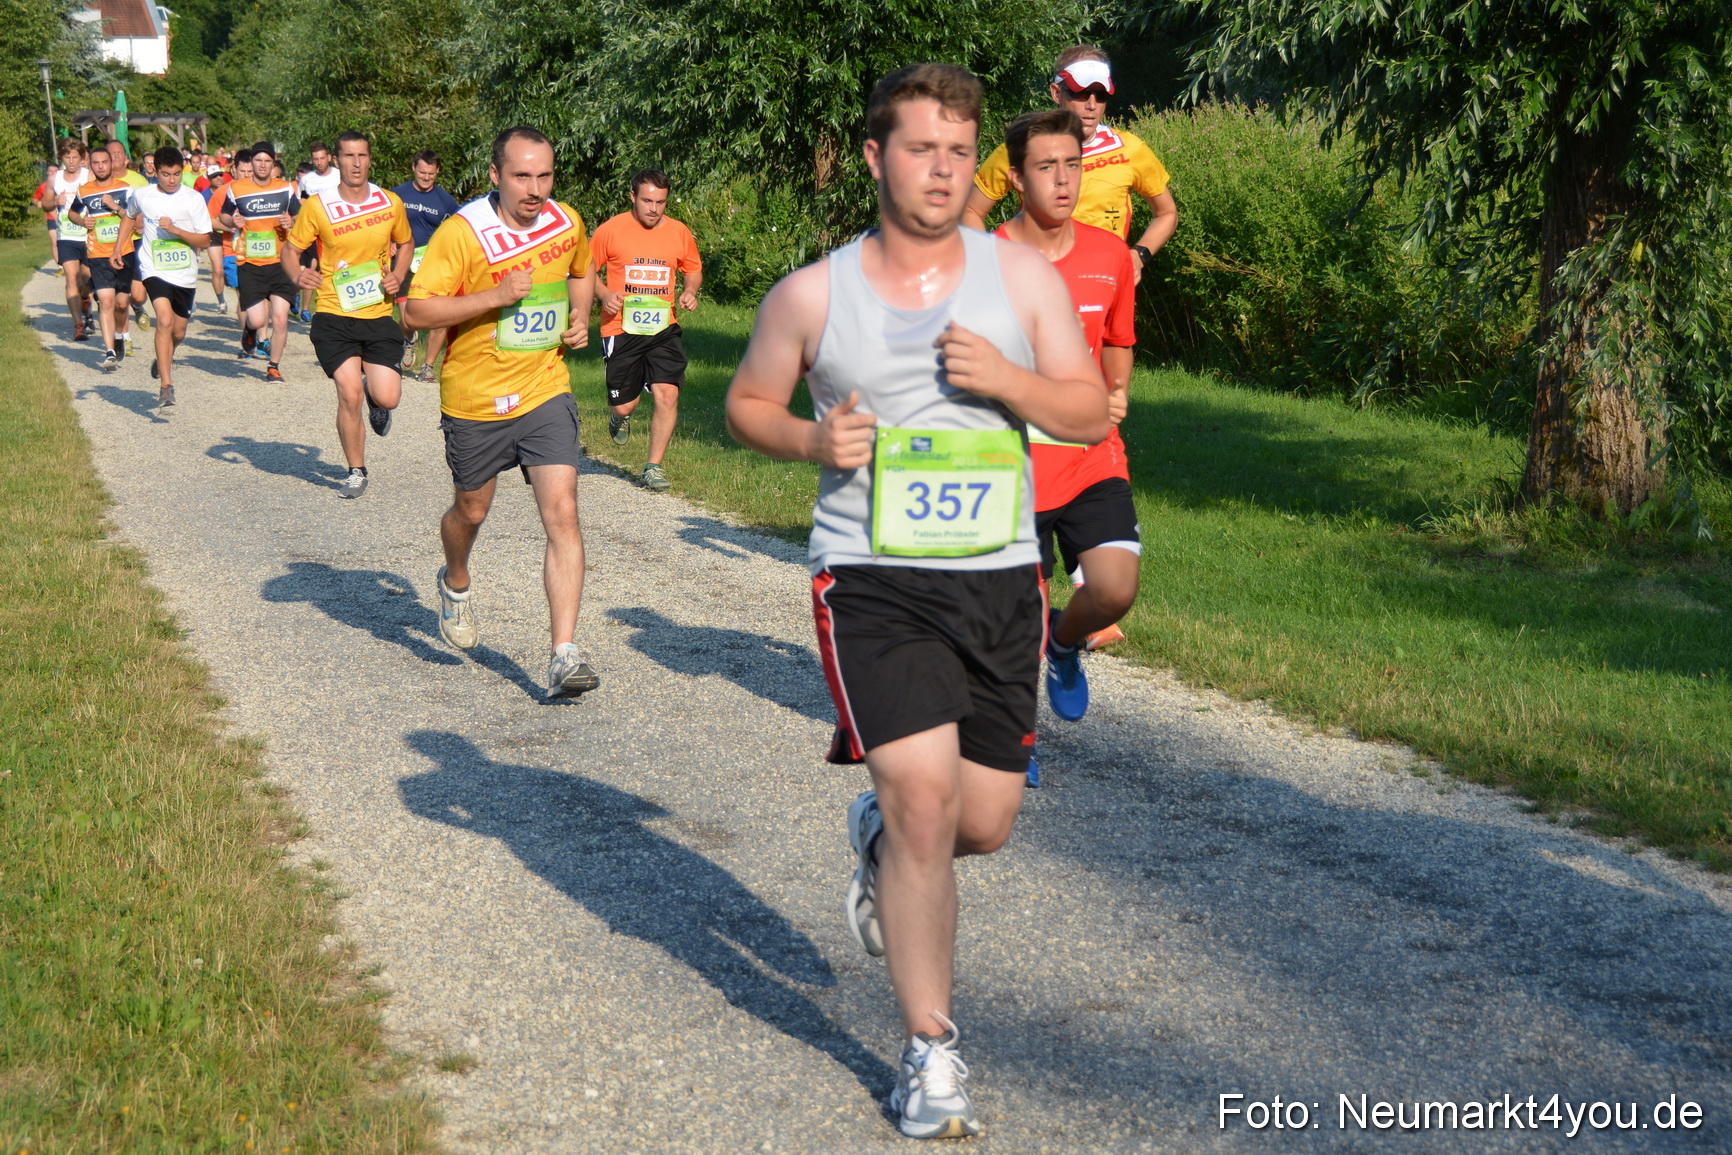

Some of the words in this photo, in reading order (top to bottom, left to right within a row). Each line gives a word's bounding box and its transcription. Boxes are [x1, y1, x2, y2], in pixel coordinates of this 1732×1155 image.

[1083, 153, 1130, 173] BÖGL
[253, 202, 281, 211] Fischer
[333, 222, 362, 237] MAX
[366, 211, 395, 227] BÖGL
[252, 242, 271, 251] 450
[538, 236, 578, 266] BÖGL
[157, 251, 188, 263] 1305
[634, 257, 644, 265] 30
[647, 257, 667, 266] Jahre
[629, 270, 667, 281] OBI
[346, 280, 376, 298] 932
[624, 284, 669, 296] Neumarkt
[513, 309, 557, 334] 920
[632, 311, 661, 325] 624
[905, 482, 992, 521] 357
